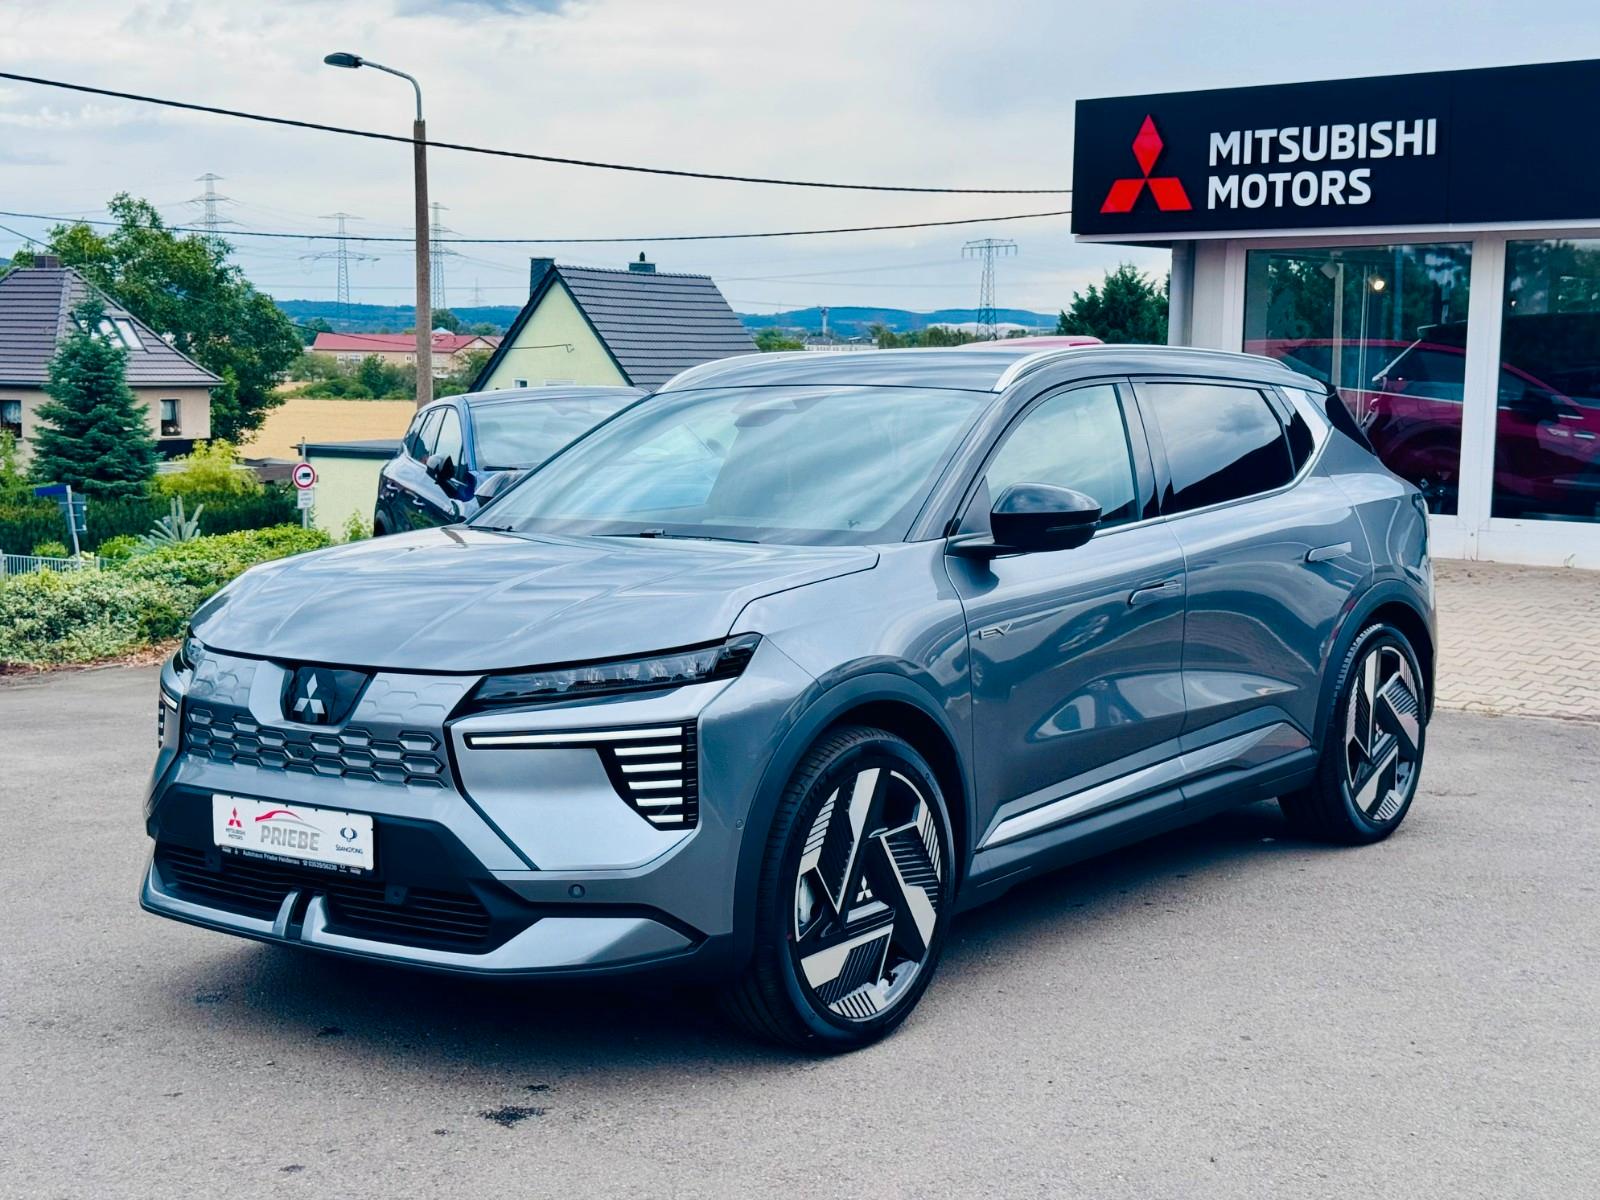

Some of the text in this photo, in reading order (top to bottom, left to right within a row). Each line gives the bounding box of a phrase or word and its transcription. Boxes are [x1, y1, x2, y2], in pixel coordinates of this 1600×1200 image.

[1208, 118, 1437, 167] MITSUBISHI
[1207, 168, 1372, 210] MOTORS
[260, 825, 320, 851] PRIEBE
